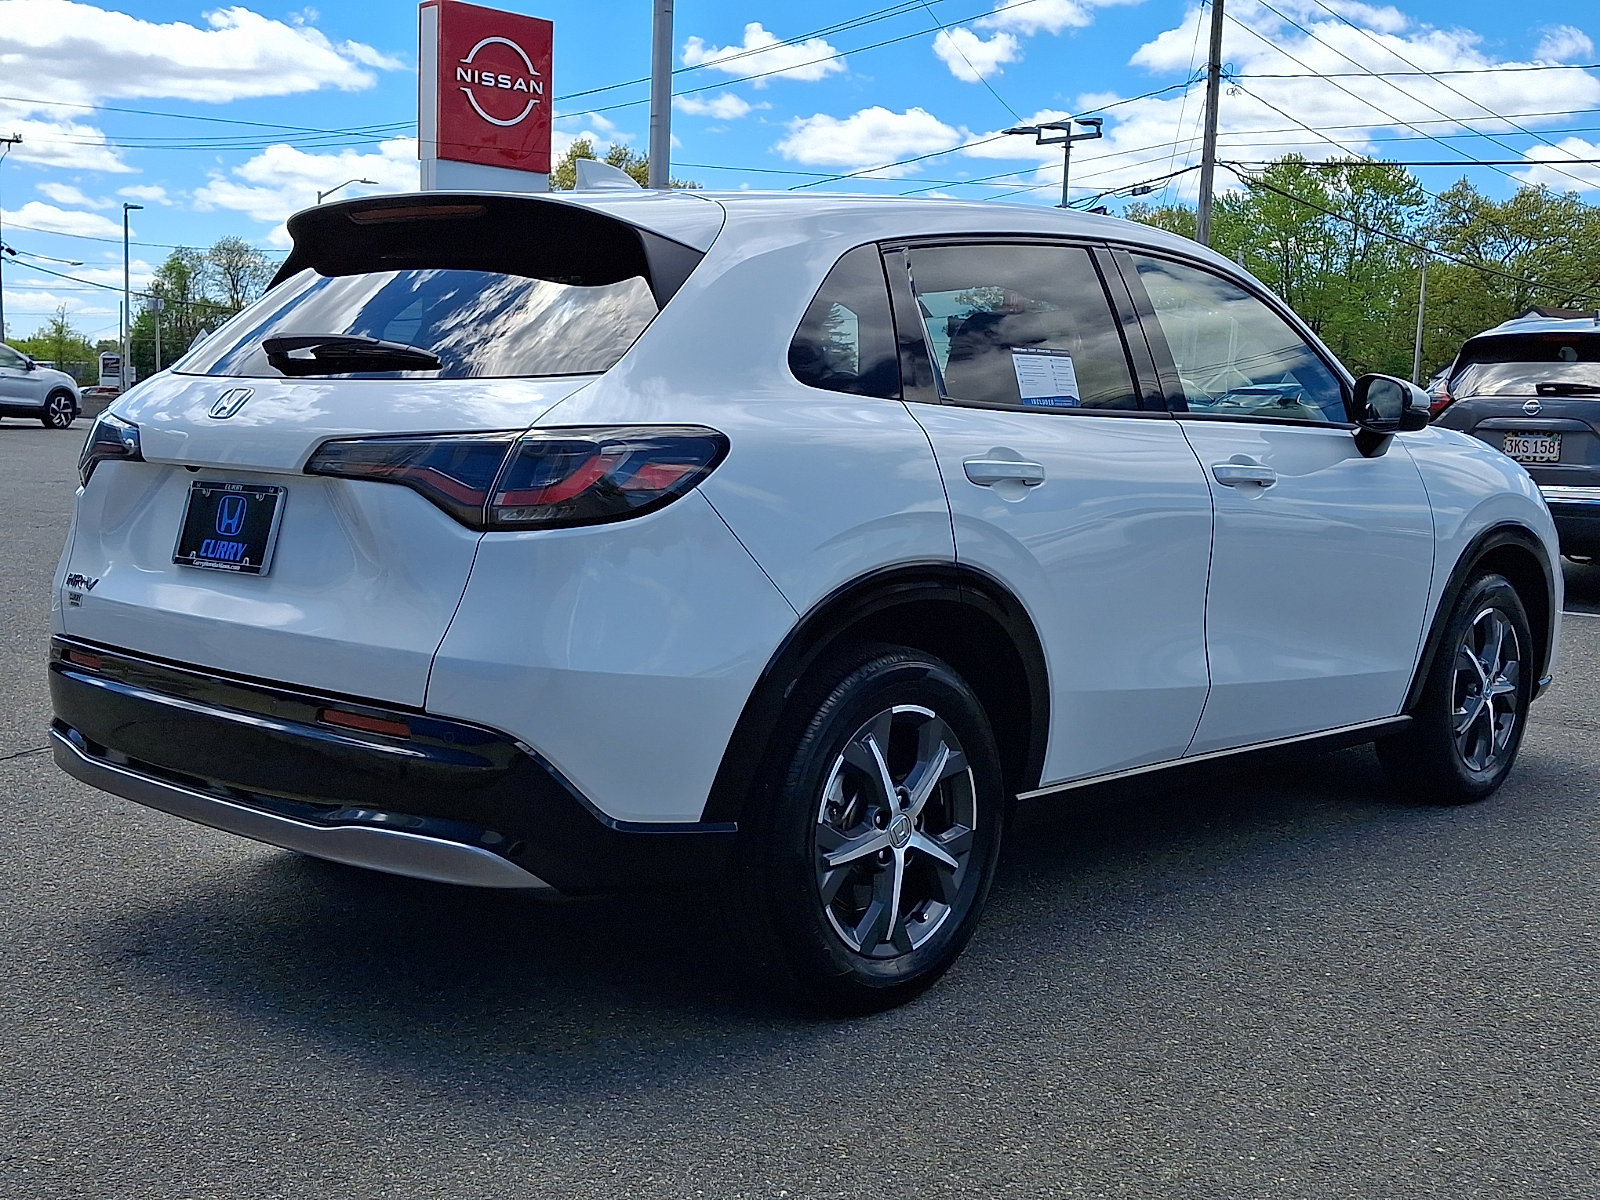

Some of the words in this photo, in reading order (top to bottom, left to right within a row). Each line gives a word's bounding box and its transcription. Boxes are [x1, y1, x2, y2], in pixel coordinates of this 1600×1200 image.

[456, 66, 543, 95] NISSAN
[1506, 439, 1529, 454] 3KS
[1532, 439, 1556, 454] 158
[200, 539, 248, 561] CURRY
